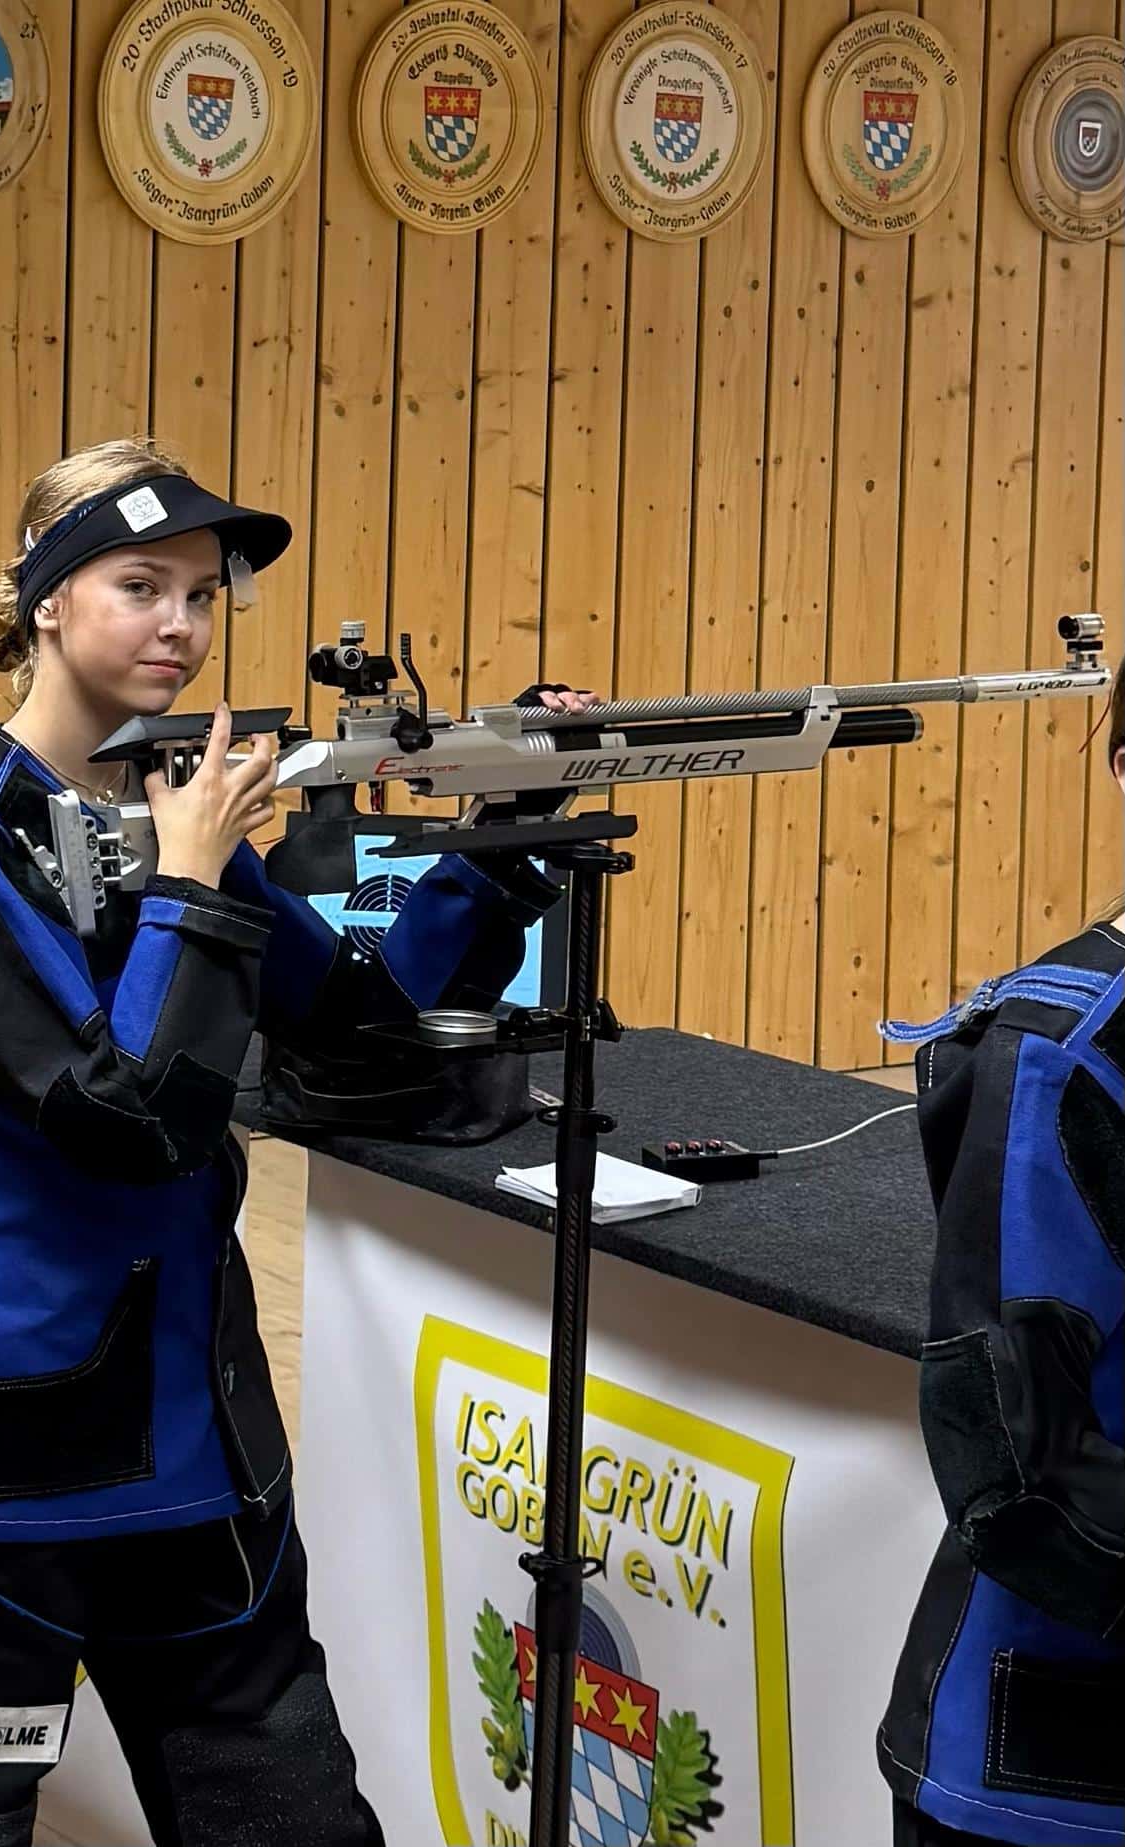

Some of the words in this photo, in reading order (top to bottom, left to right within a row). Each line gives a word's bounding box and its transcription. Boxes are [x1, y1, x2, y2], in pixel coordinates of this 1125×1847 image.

[122, 43, 141, 73] 20
[283, 66, 299, 89] 19
[735, 53, 749, 69] 17
[562, 749, 745, 782] WALTHER
[455, 1393, 733, 1571] ISAGRÜN
[456, 1462, 612, 1581] GOBN
